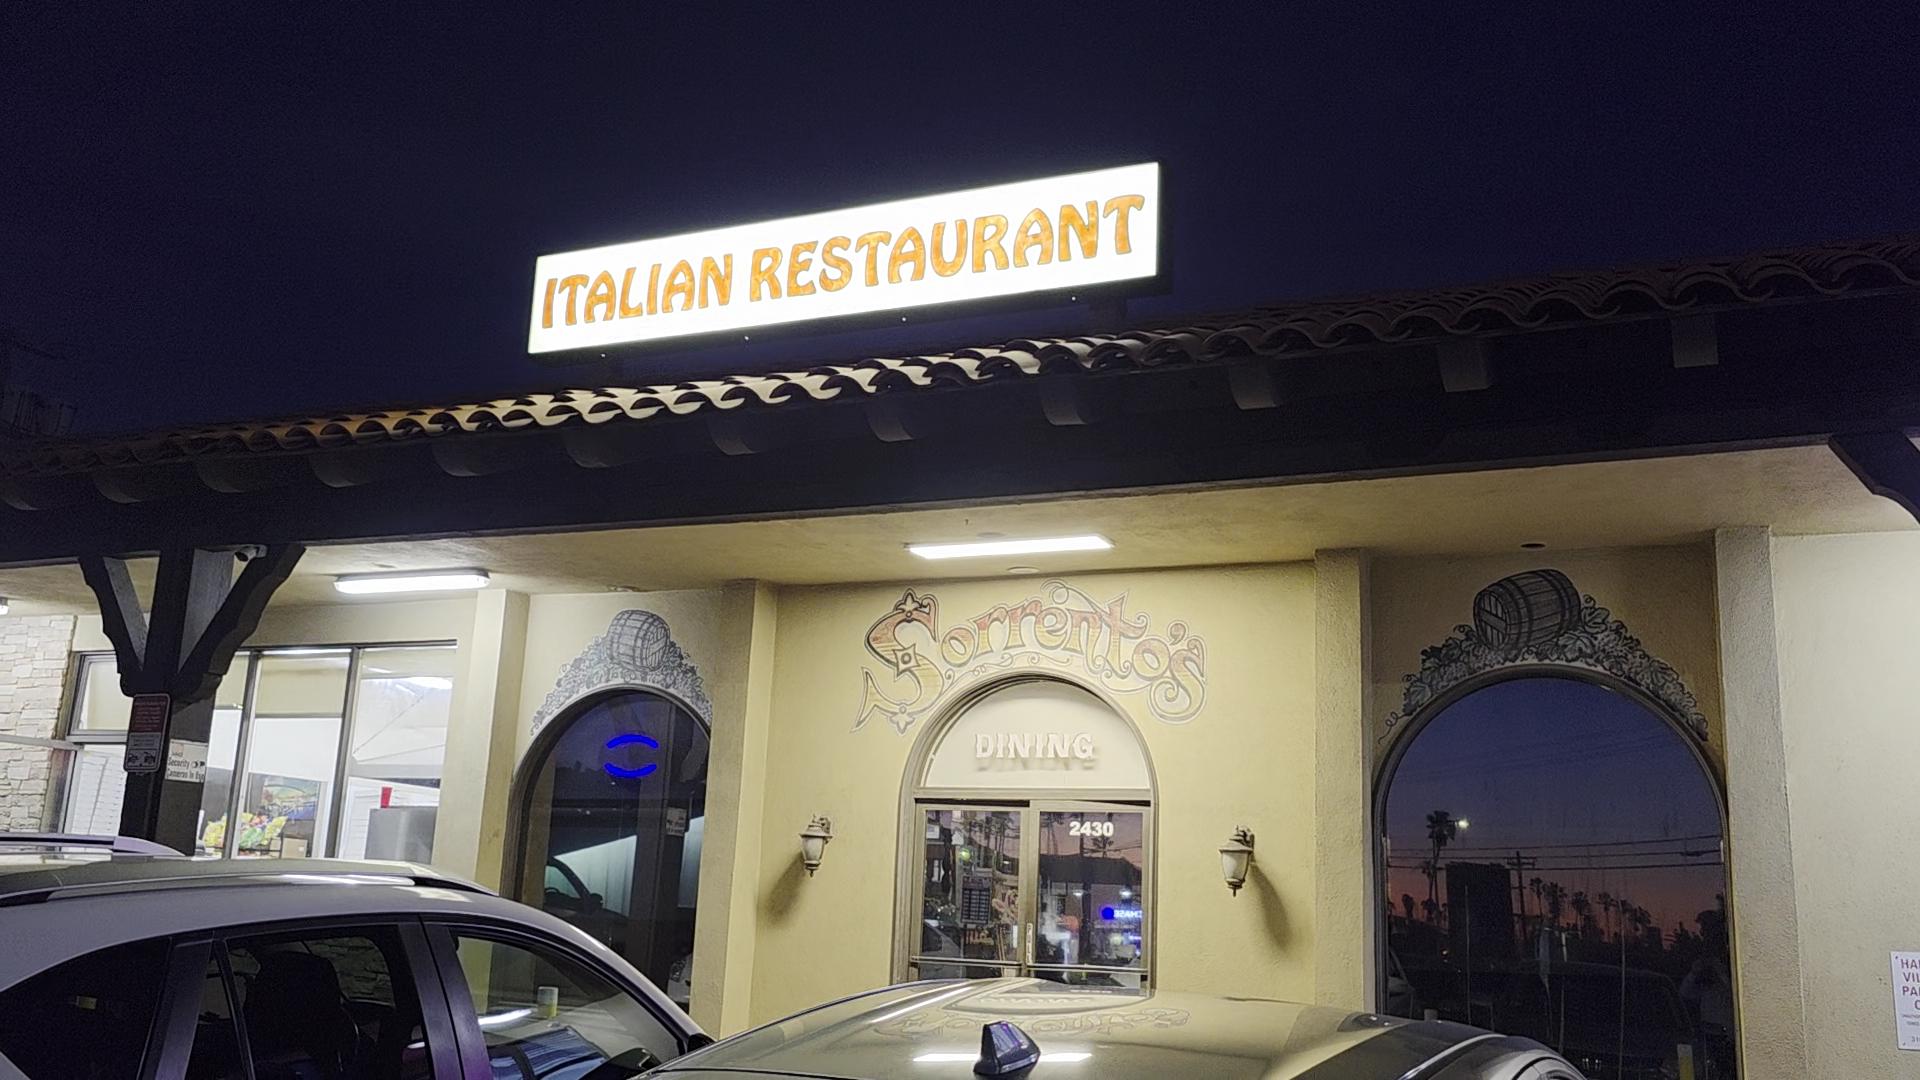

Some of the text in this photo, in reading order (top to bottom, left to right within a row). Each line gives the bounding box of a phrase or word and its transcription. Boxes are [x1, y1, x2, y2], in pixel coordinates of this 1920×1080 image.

[542, 195, 1145, 328] ITALIAN RESTAURANT
[850, 581, 1206, 734] Sorrento's
[975, 733, 1094, 760] DINING
[1069, 821, 1114, 837] 2430
[1901, 959, 1920, 969] HA
[1903, 986, 1920, 996] PA
